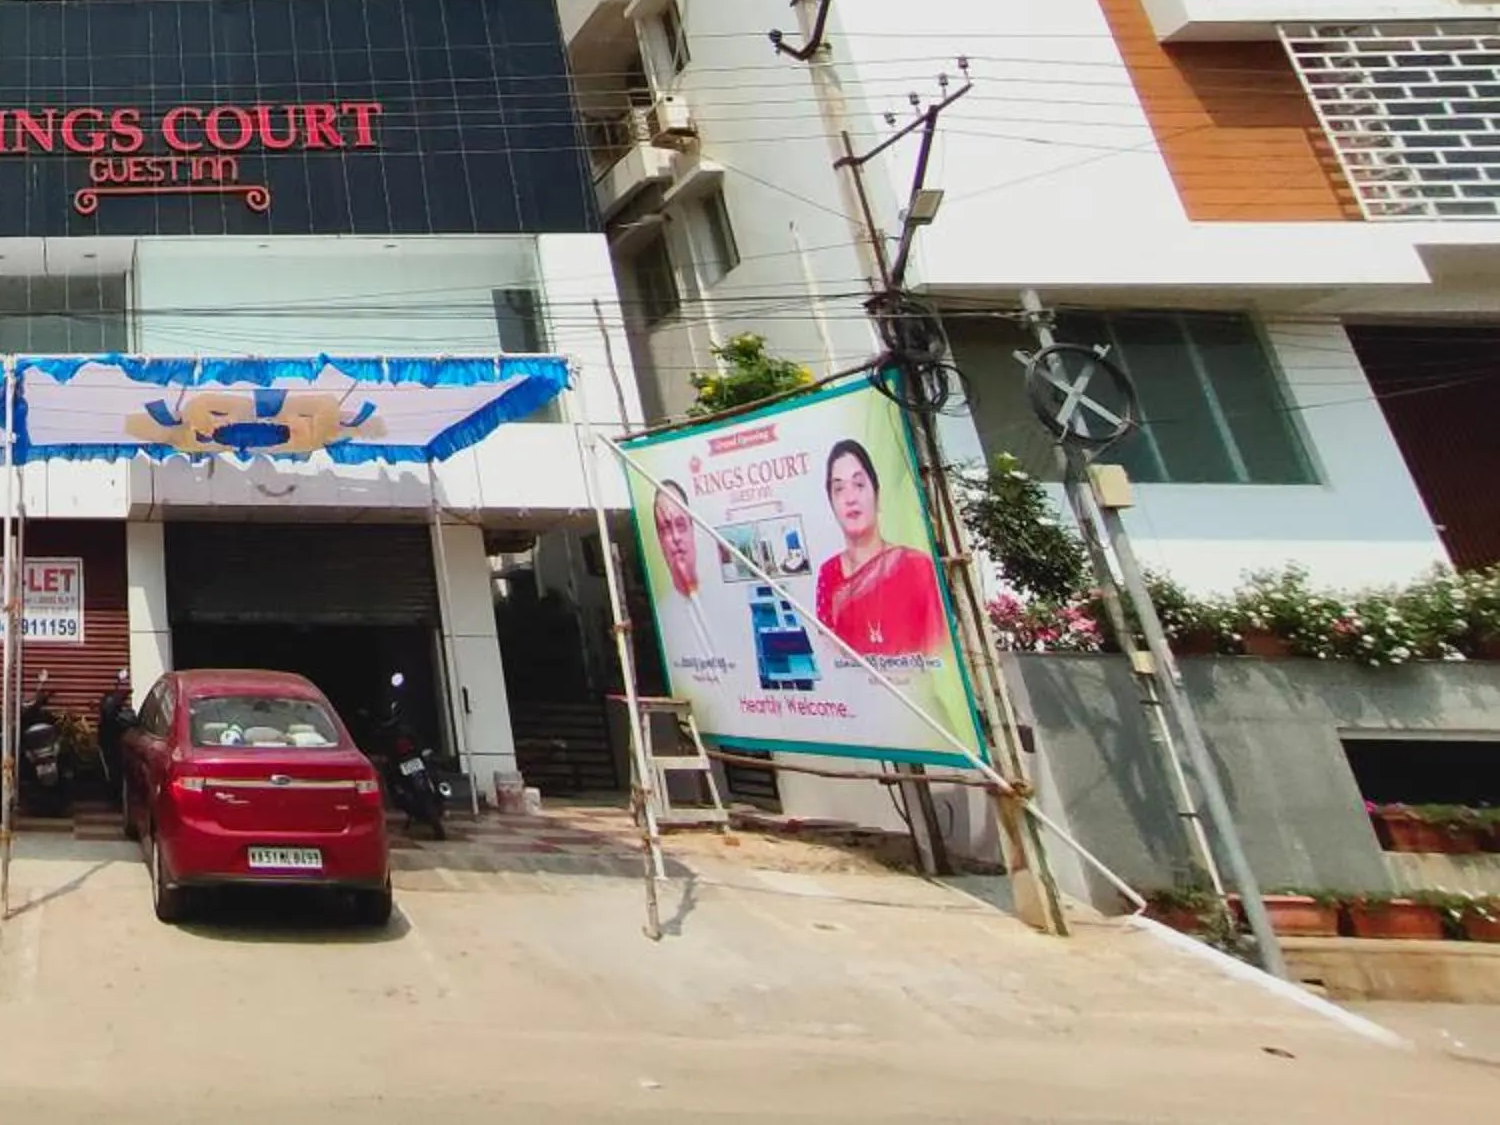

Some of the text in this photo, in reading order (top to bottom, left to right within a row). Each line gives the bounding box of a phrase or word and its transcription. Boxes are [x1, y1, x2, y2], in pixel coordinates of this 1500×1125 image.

[162, 102, 383, 151] COURT
[90, 156, 183, 183] GUEST
[692, 452, 810, 496] KINGS COURT
